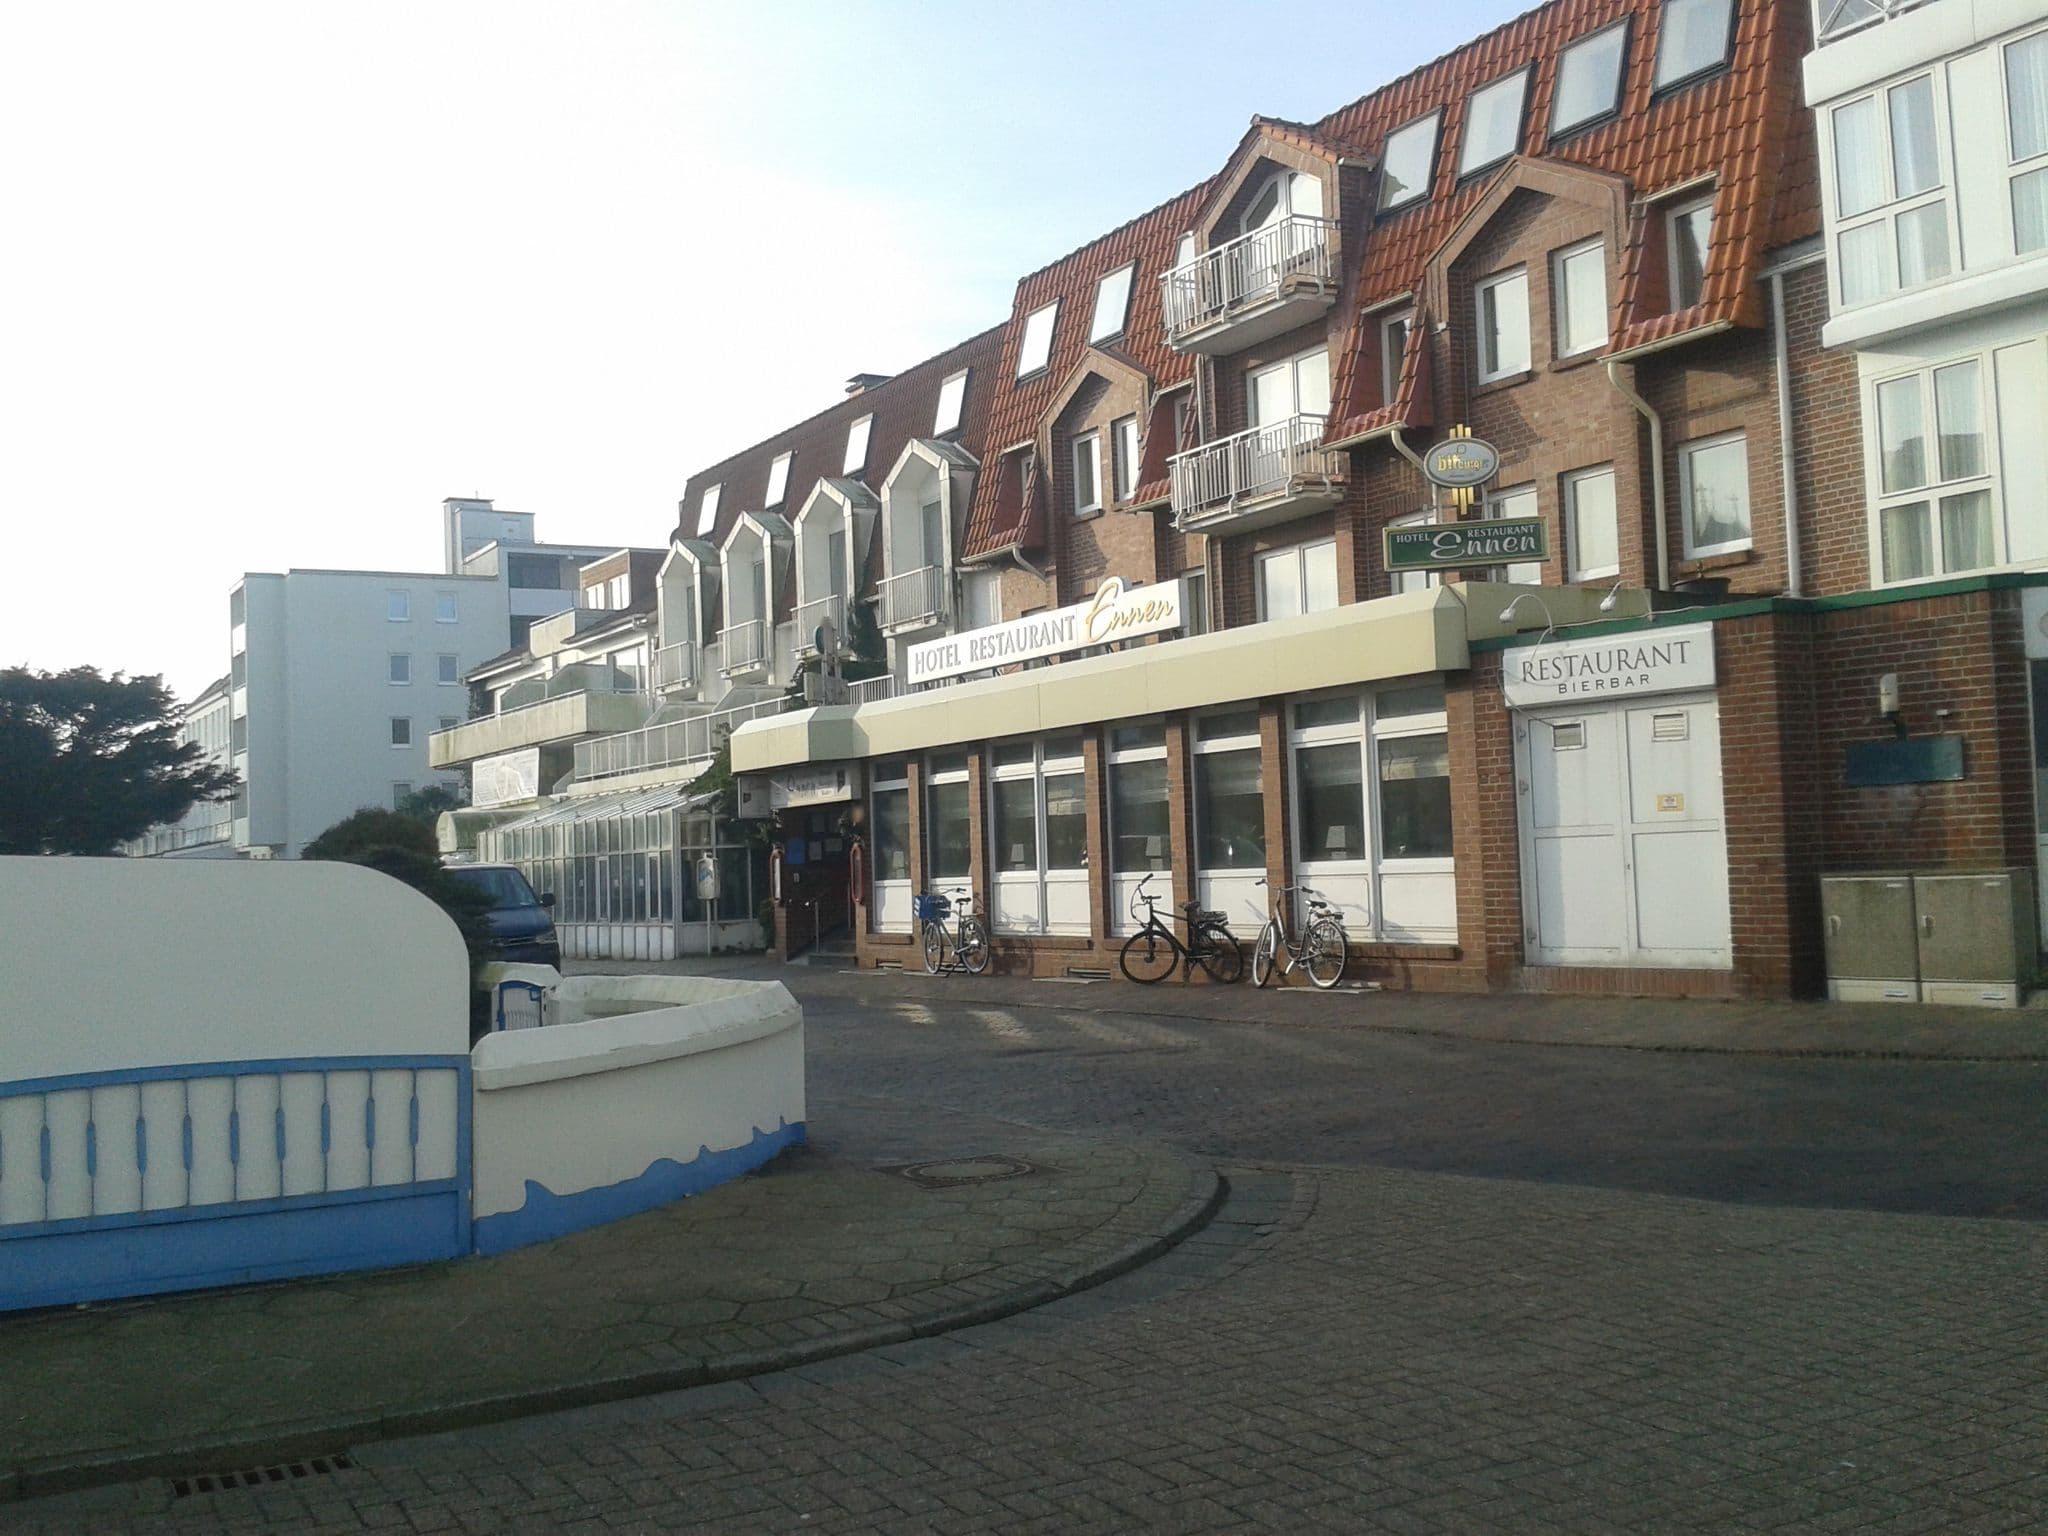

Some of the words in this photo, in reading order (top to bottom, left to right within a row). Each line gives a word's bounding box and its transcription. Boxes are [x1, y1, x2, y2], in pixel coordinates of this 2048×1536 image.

[1396, 533, 1430, 543] HOTEL
[1467, 524, 1536, 538] RESTAURANT
[1430, 531, 1536, 559] Ennen
[914, 643, 961, 675] HOTEL
[969, 614, 1075, 663] RESTAURANT
[1085, 580, 1174, 643] Ennen
[1522, 640, 1691, 682] RESTAURANT
[1558, 674, 1650, 694] BIERBAR
